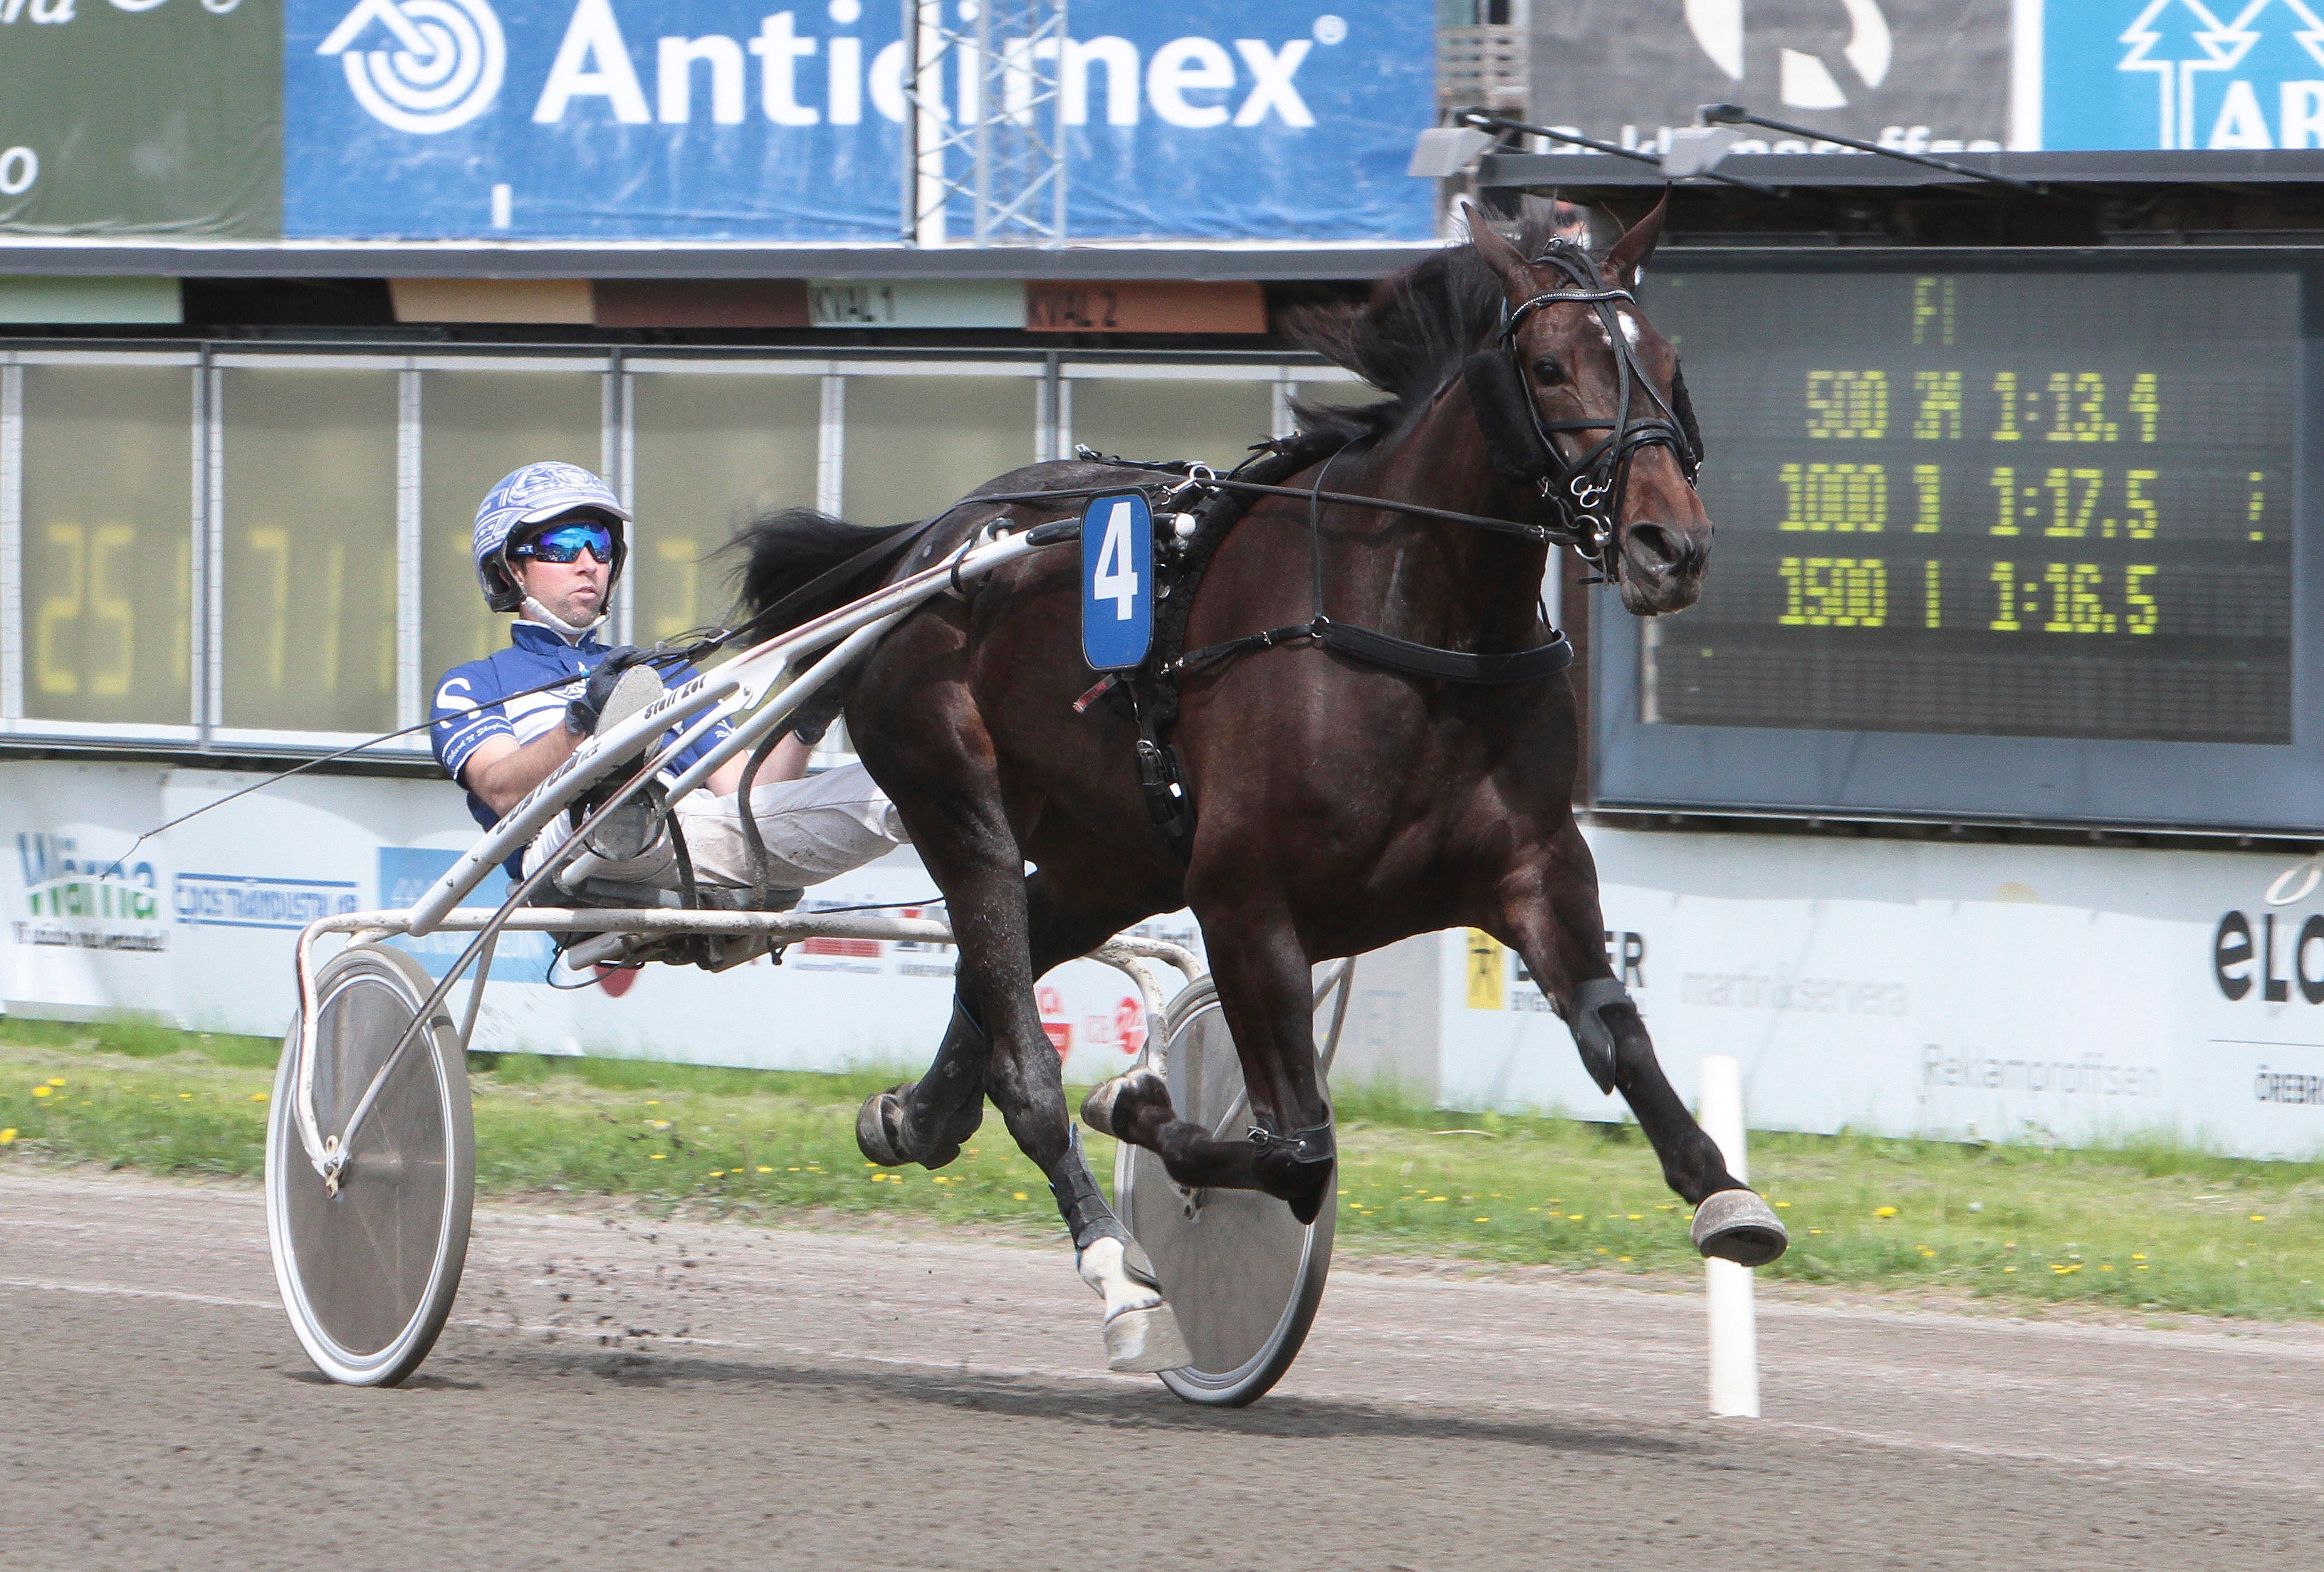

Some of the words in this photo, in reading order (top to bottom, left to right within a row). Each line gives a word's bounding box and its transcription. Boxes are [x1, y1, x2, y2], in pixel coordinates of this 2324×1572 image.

[1779, 463, 1888, 533] 1000
[1989, 466, 2158, 540] 1:17.5
[1094, 501, 1138, 621] 4
[1779, 557, 1888, 627] 1500
[1989, 561, 2159, 635] 1:16.5
